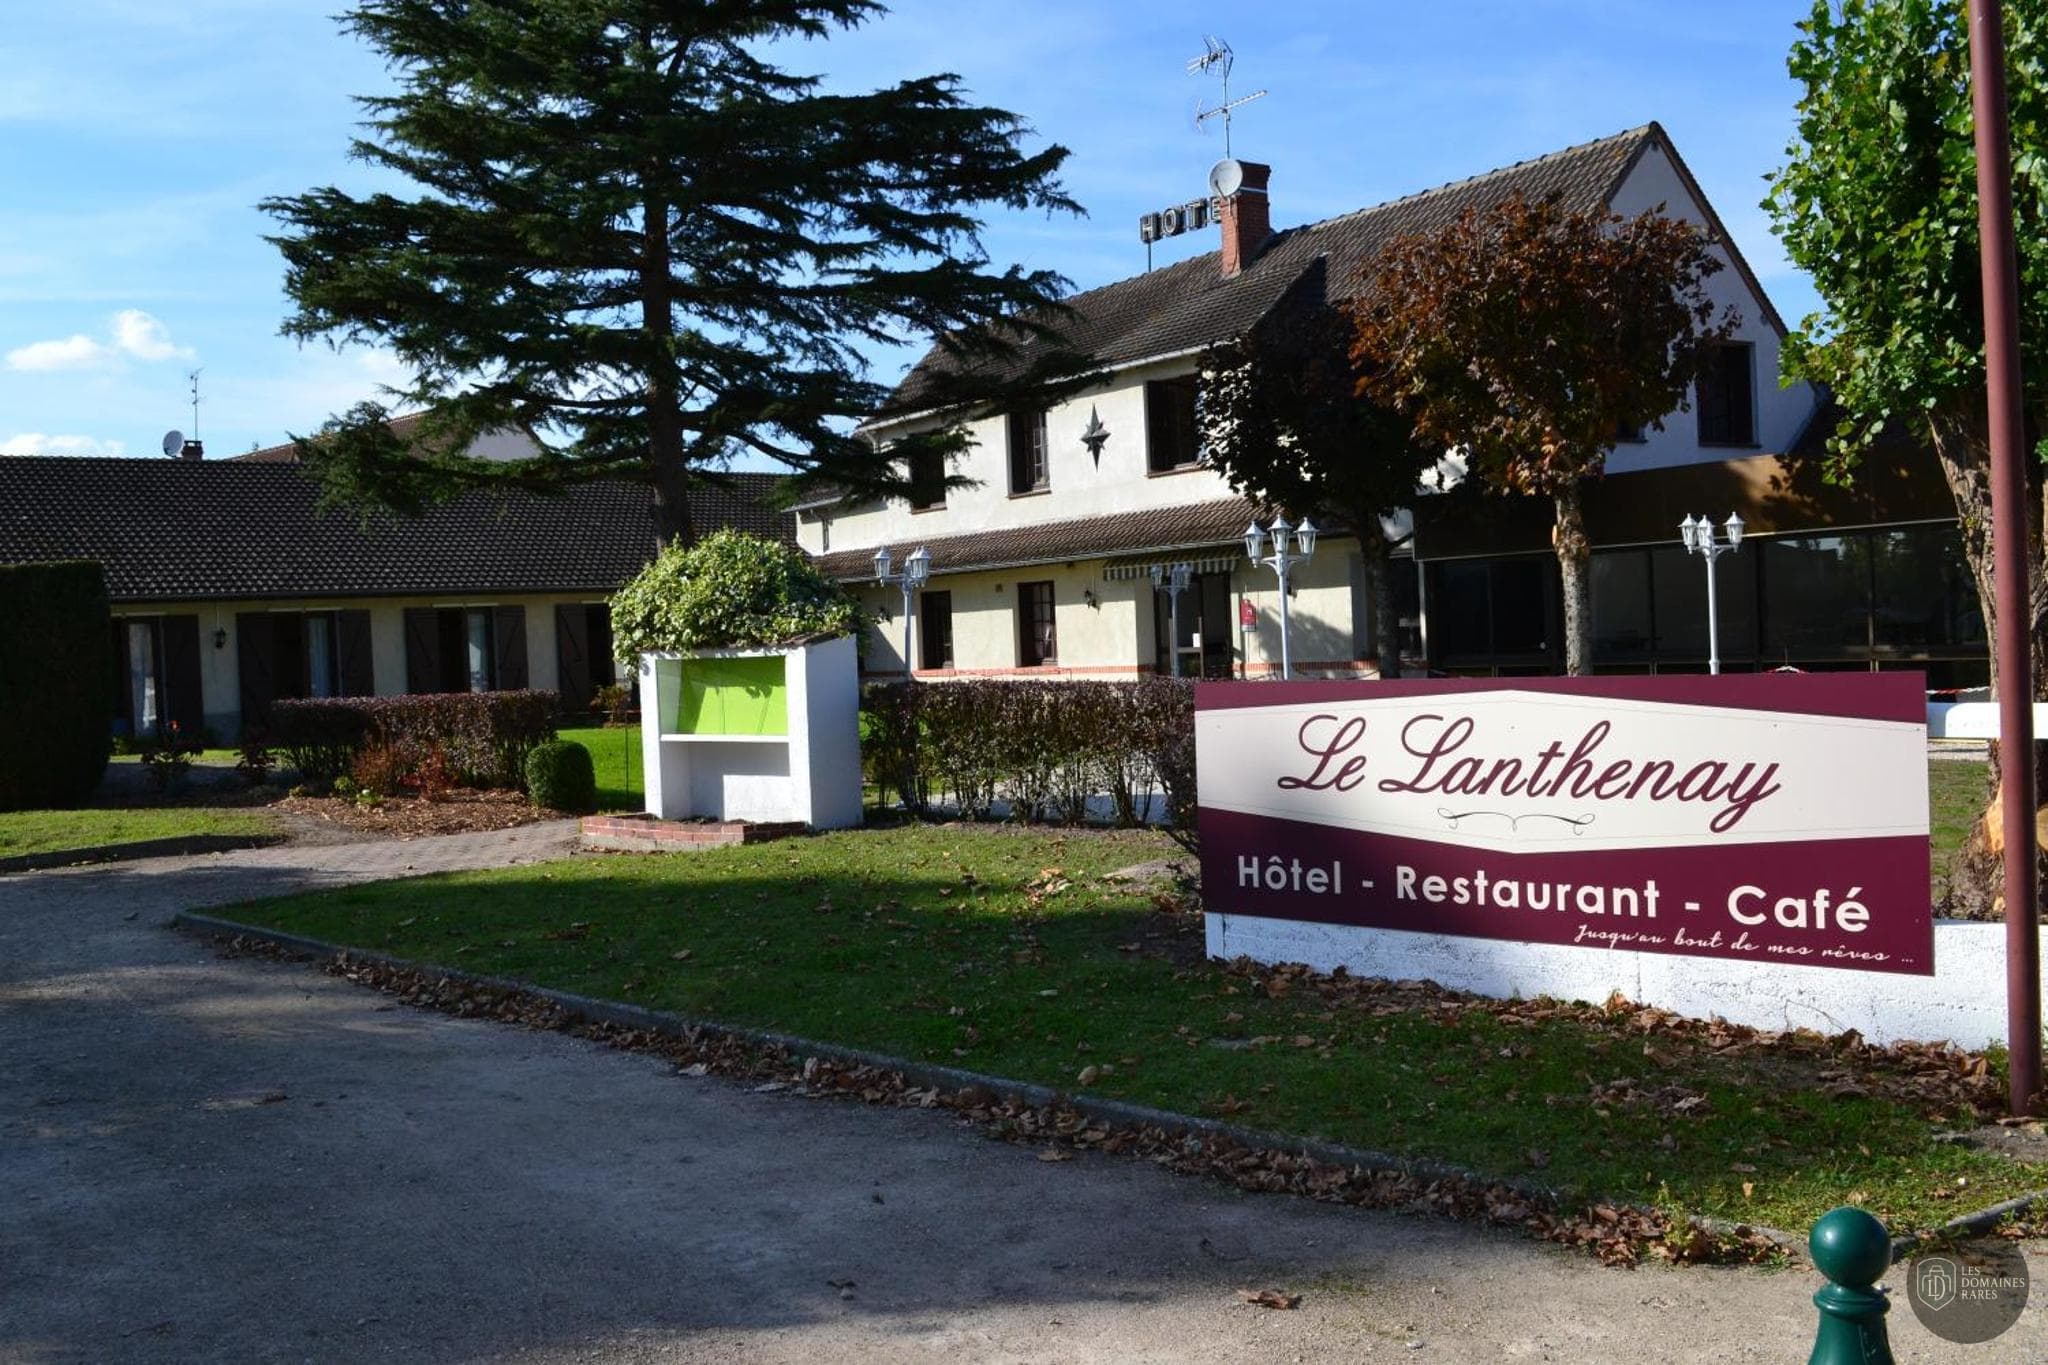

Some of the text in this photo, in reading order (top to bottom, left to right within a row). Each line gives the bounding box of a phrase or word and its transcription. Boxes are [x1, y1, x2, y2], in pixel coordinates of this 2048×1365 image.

[1140, 196, 1222, 244] HOTE
[1277, 714, 1782, 834] Le Lanthenay
[1237, 855, 1342, 895] Hôtel
[1395, 865, 1661, 918] Restaurant
[1727, 885, 1871, 933] Café
[1673, 927, 1724, 949] bout
[1730, 931, 1761, 952] de
[1767, 943, 1814, 956] mes
[1821, 945, 1892, 962] rêves
